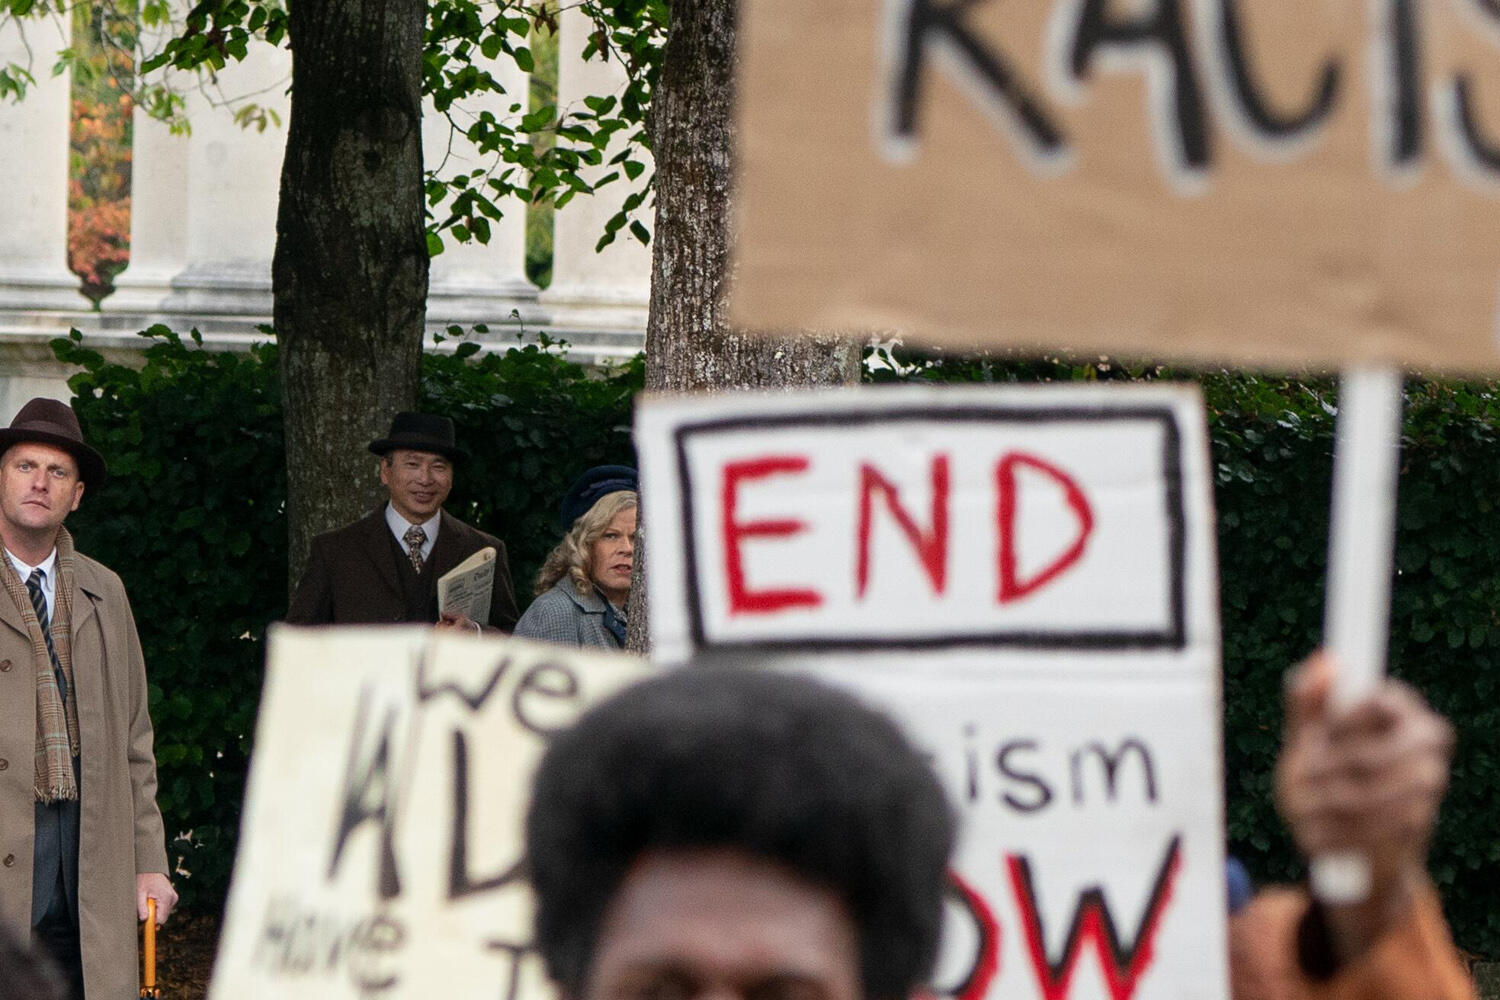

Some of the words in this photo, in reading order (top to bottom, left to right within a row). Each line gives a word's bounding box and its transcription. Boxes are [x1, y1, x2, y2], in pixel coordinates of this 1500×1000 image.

[721, 448, 1097, 620] END
[326, 678, 533, 900] AL
[965, 722, 1164, 814] ism
